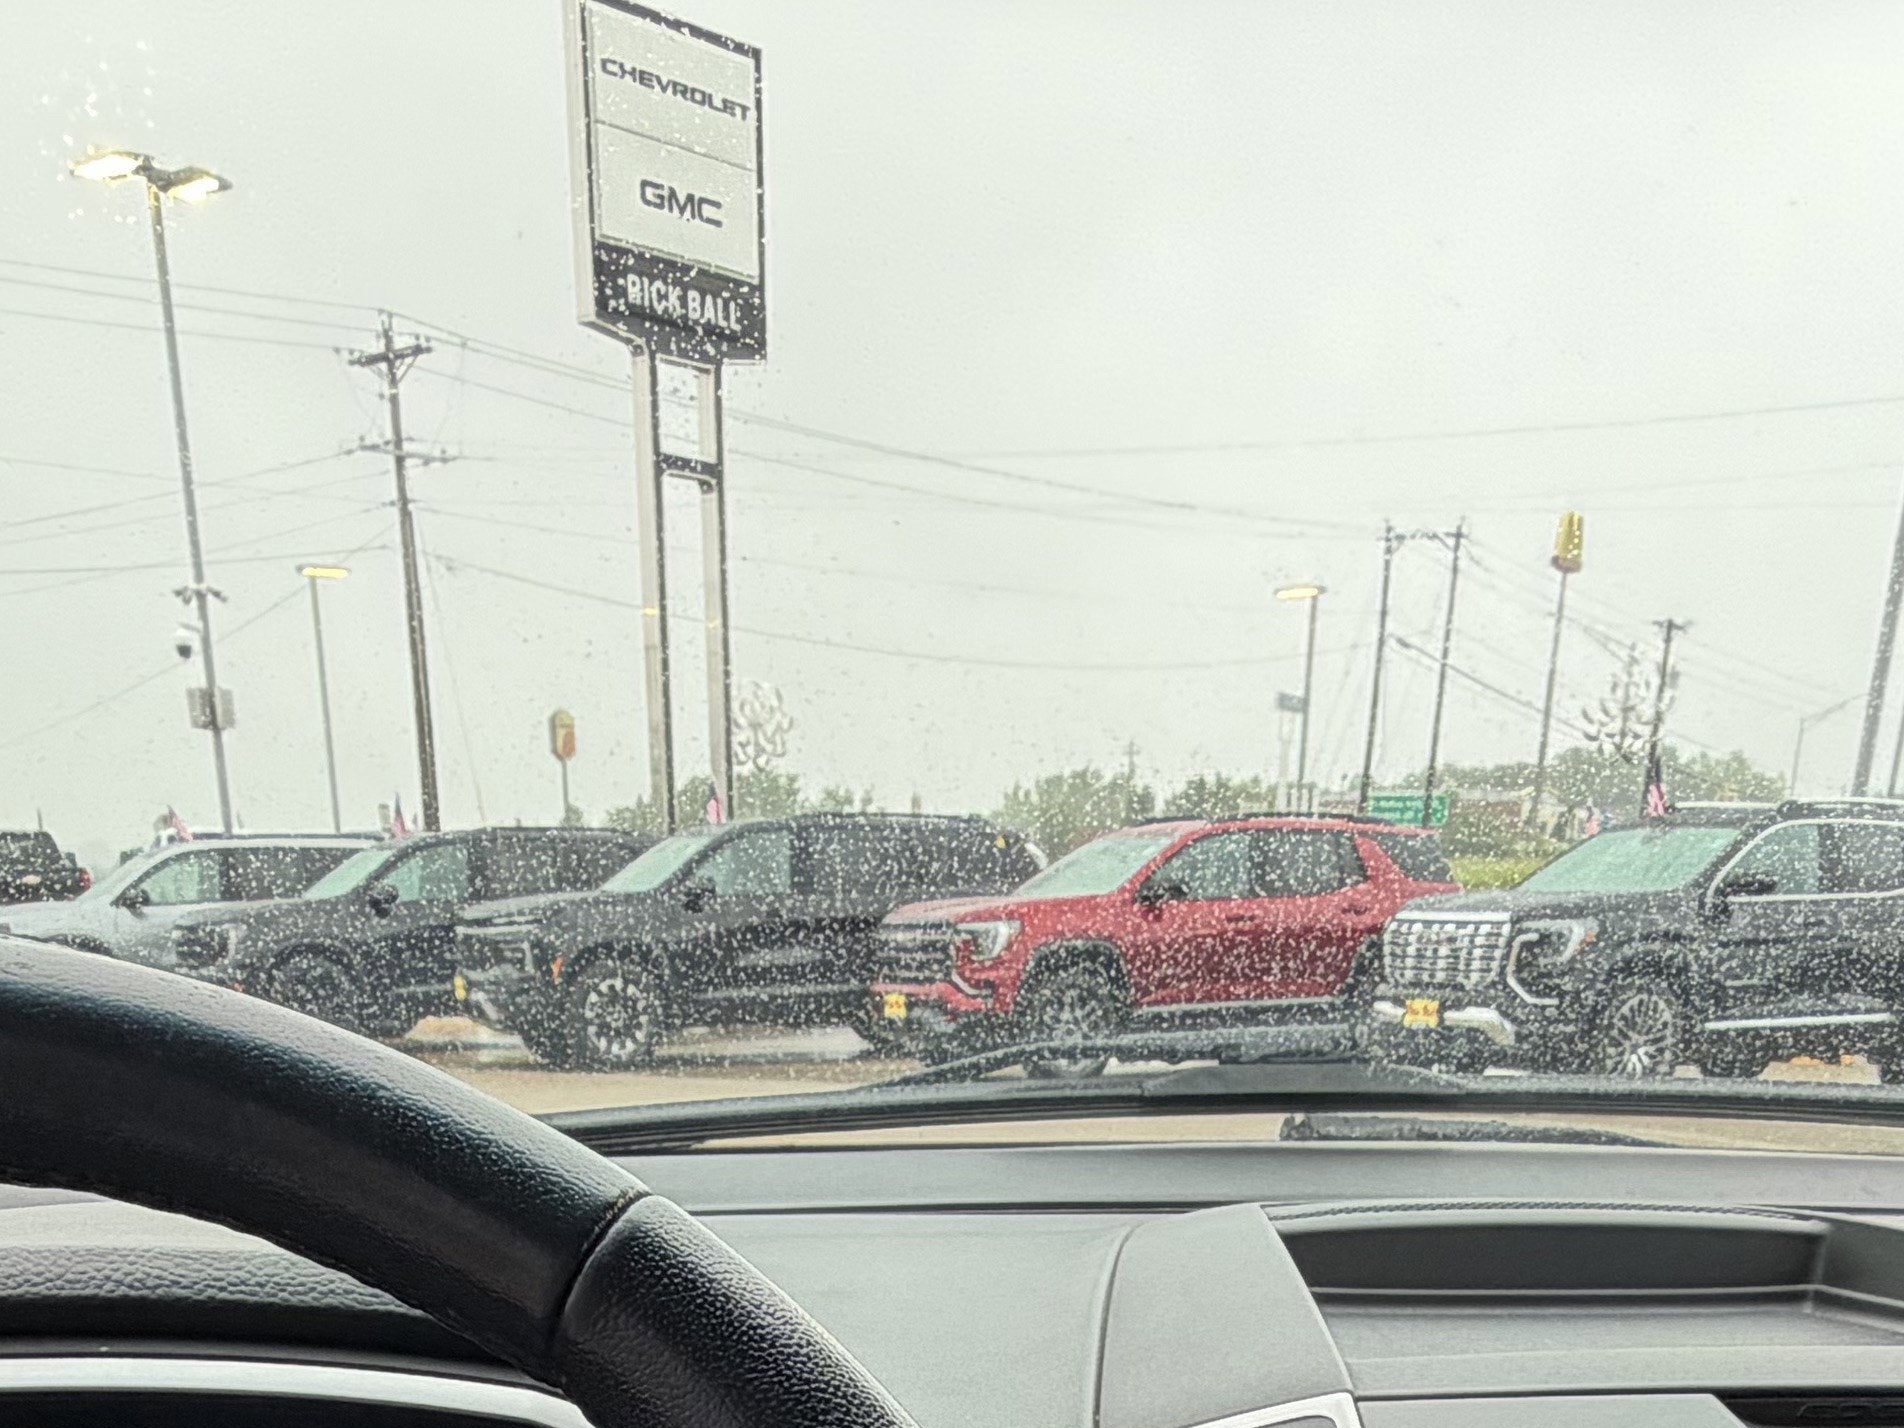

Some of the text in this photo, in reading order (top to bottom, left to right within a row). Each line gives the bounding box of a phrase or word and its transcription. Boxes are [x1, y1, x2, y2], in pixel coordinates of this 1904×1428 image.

[601, 57, 751, 122] CHEVROLET
[639, 179, 723, 228] GMC
[687, 289, 743, 332] BALL
